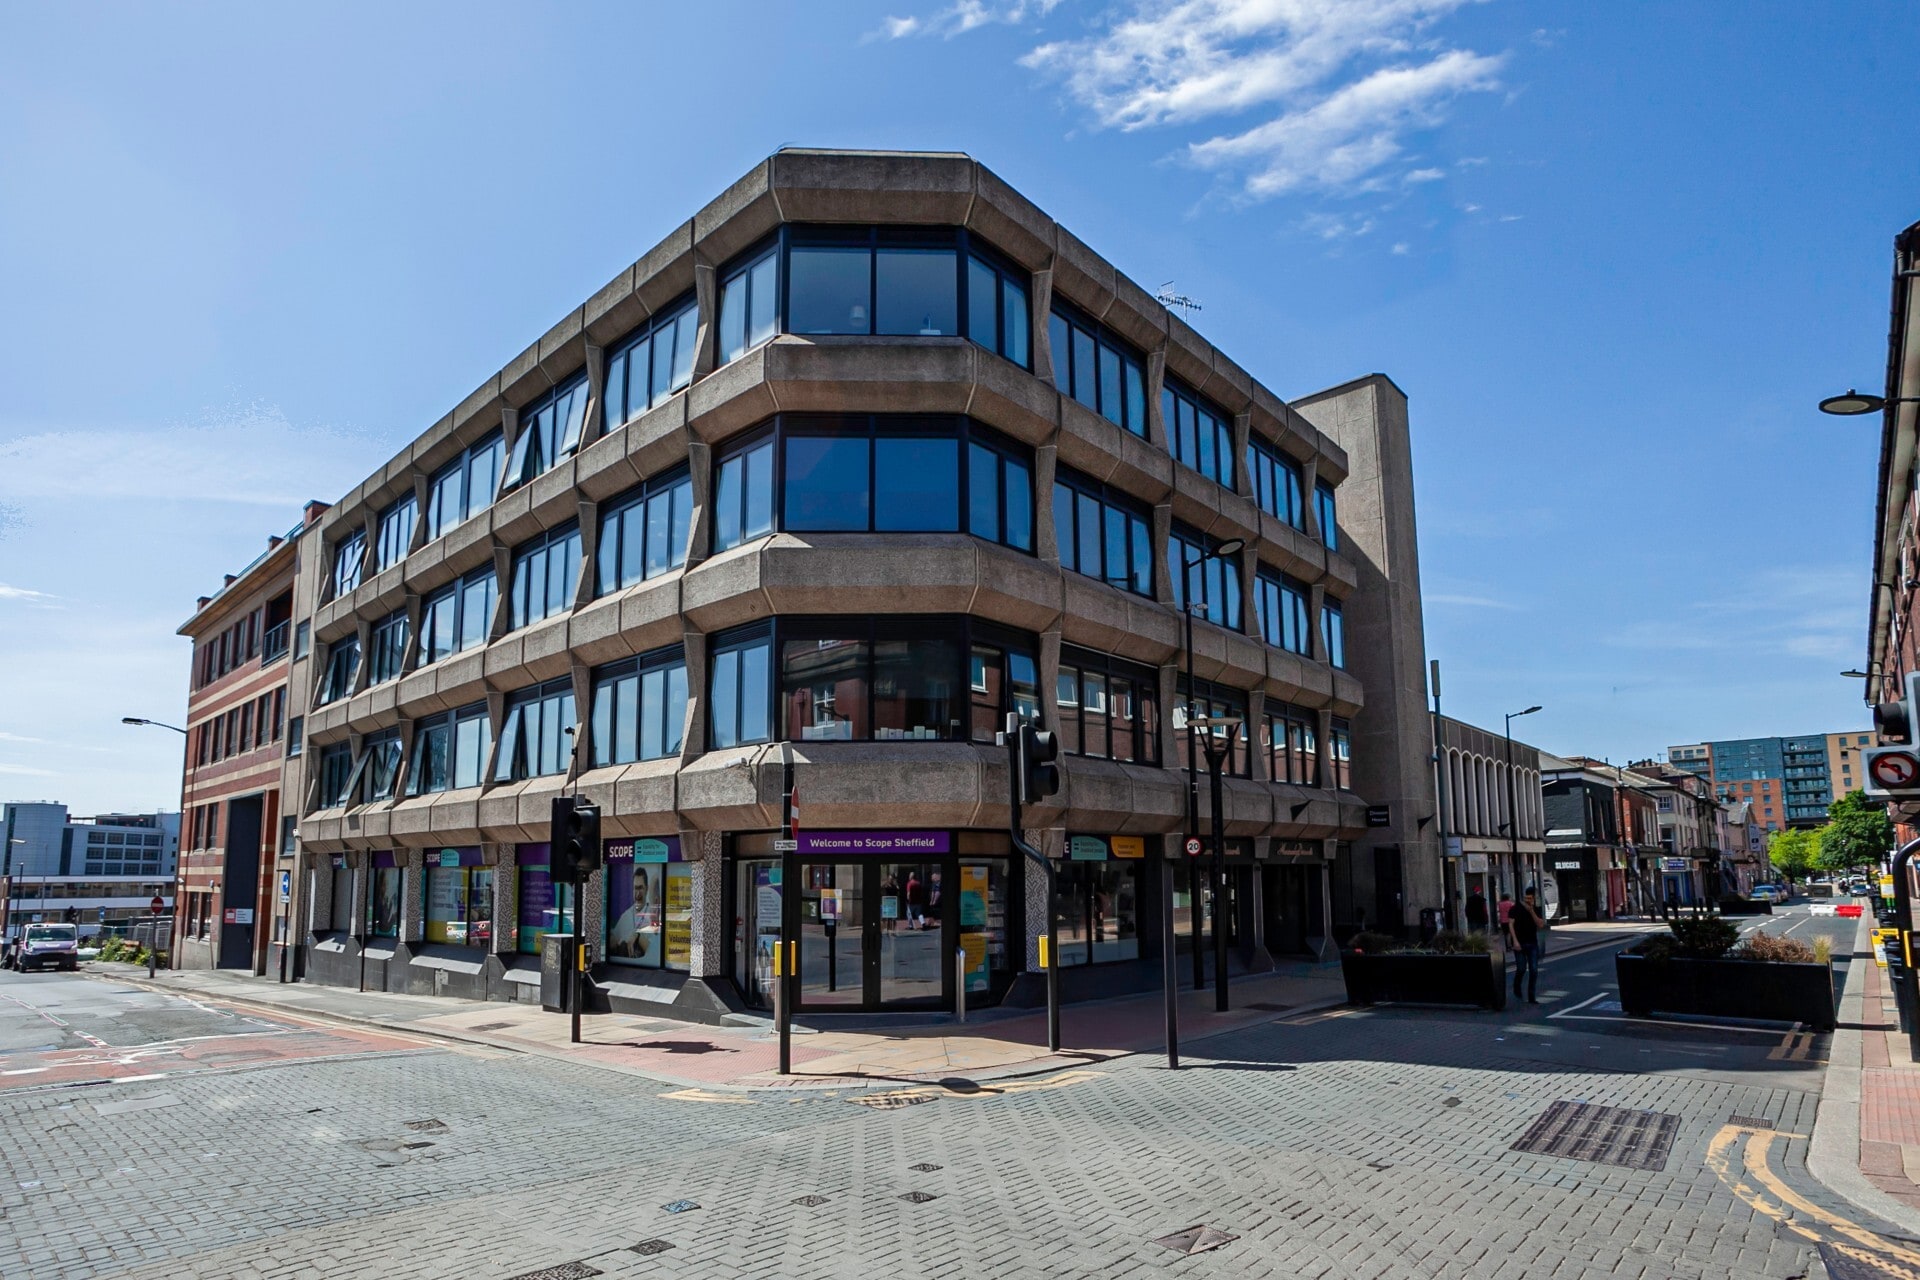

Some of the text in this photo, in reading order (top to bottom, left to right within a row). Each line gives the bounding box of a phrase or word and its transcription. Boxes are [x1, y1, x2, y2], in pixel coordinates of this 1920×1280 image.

[810, 838, 935, 849] Welcome to Scope Sheffield
[609, 845, 634, 858] SCOPE
